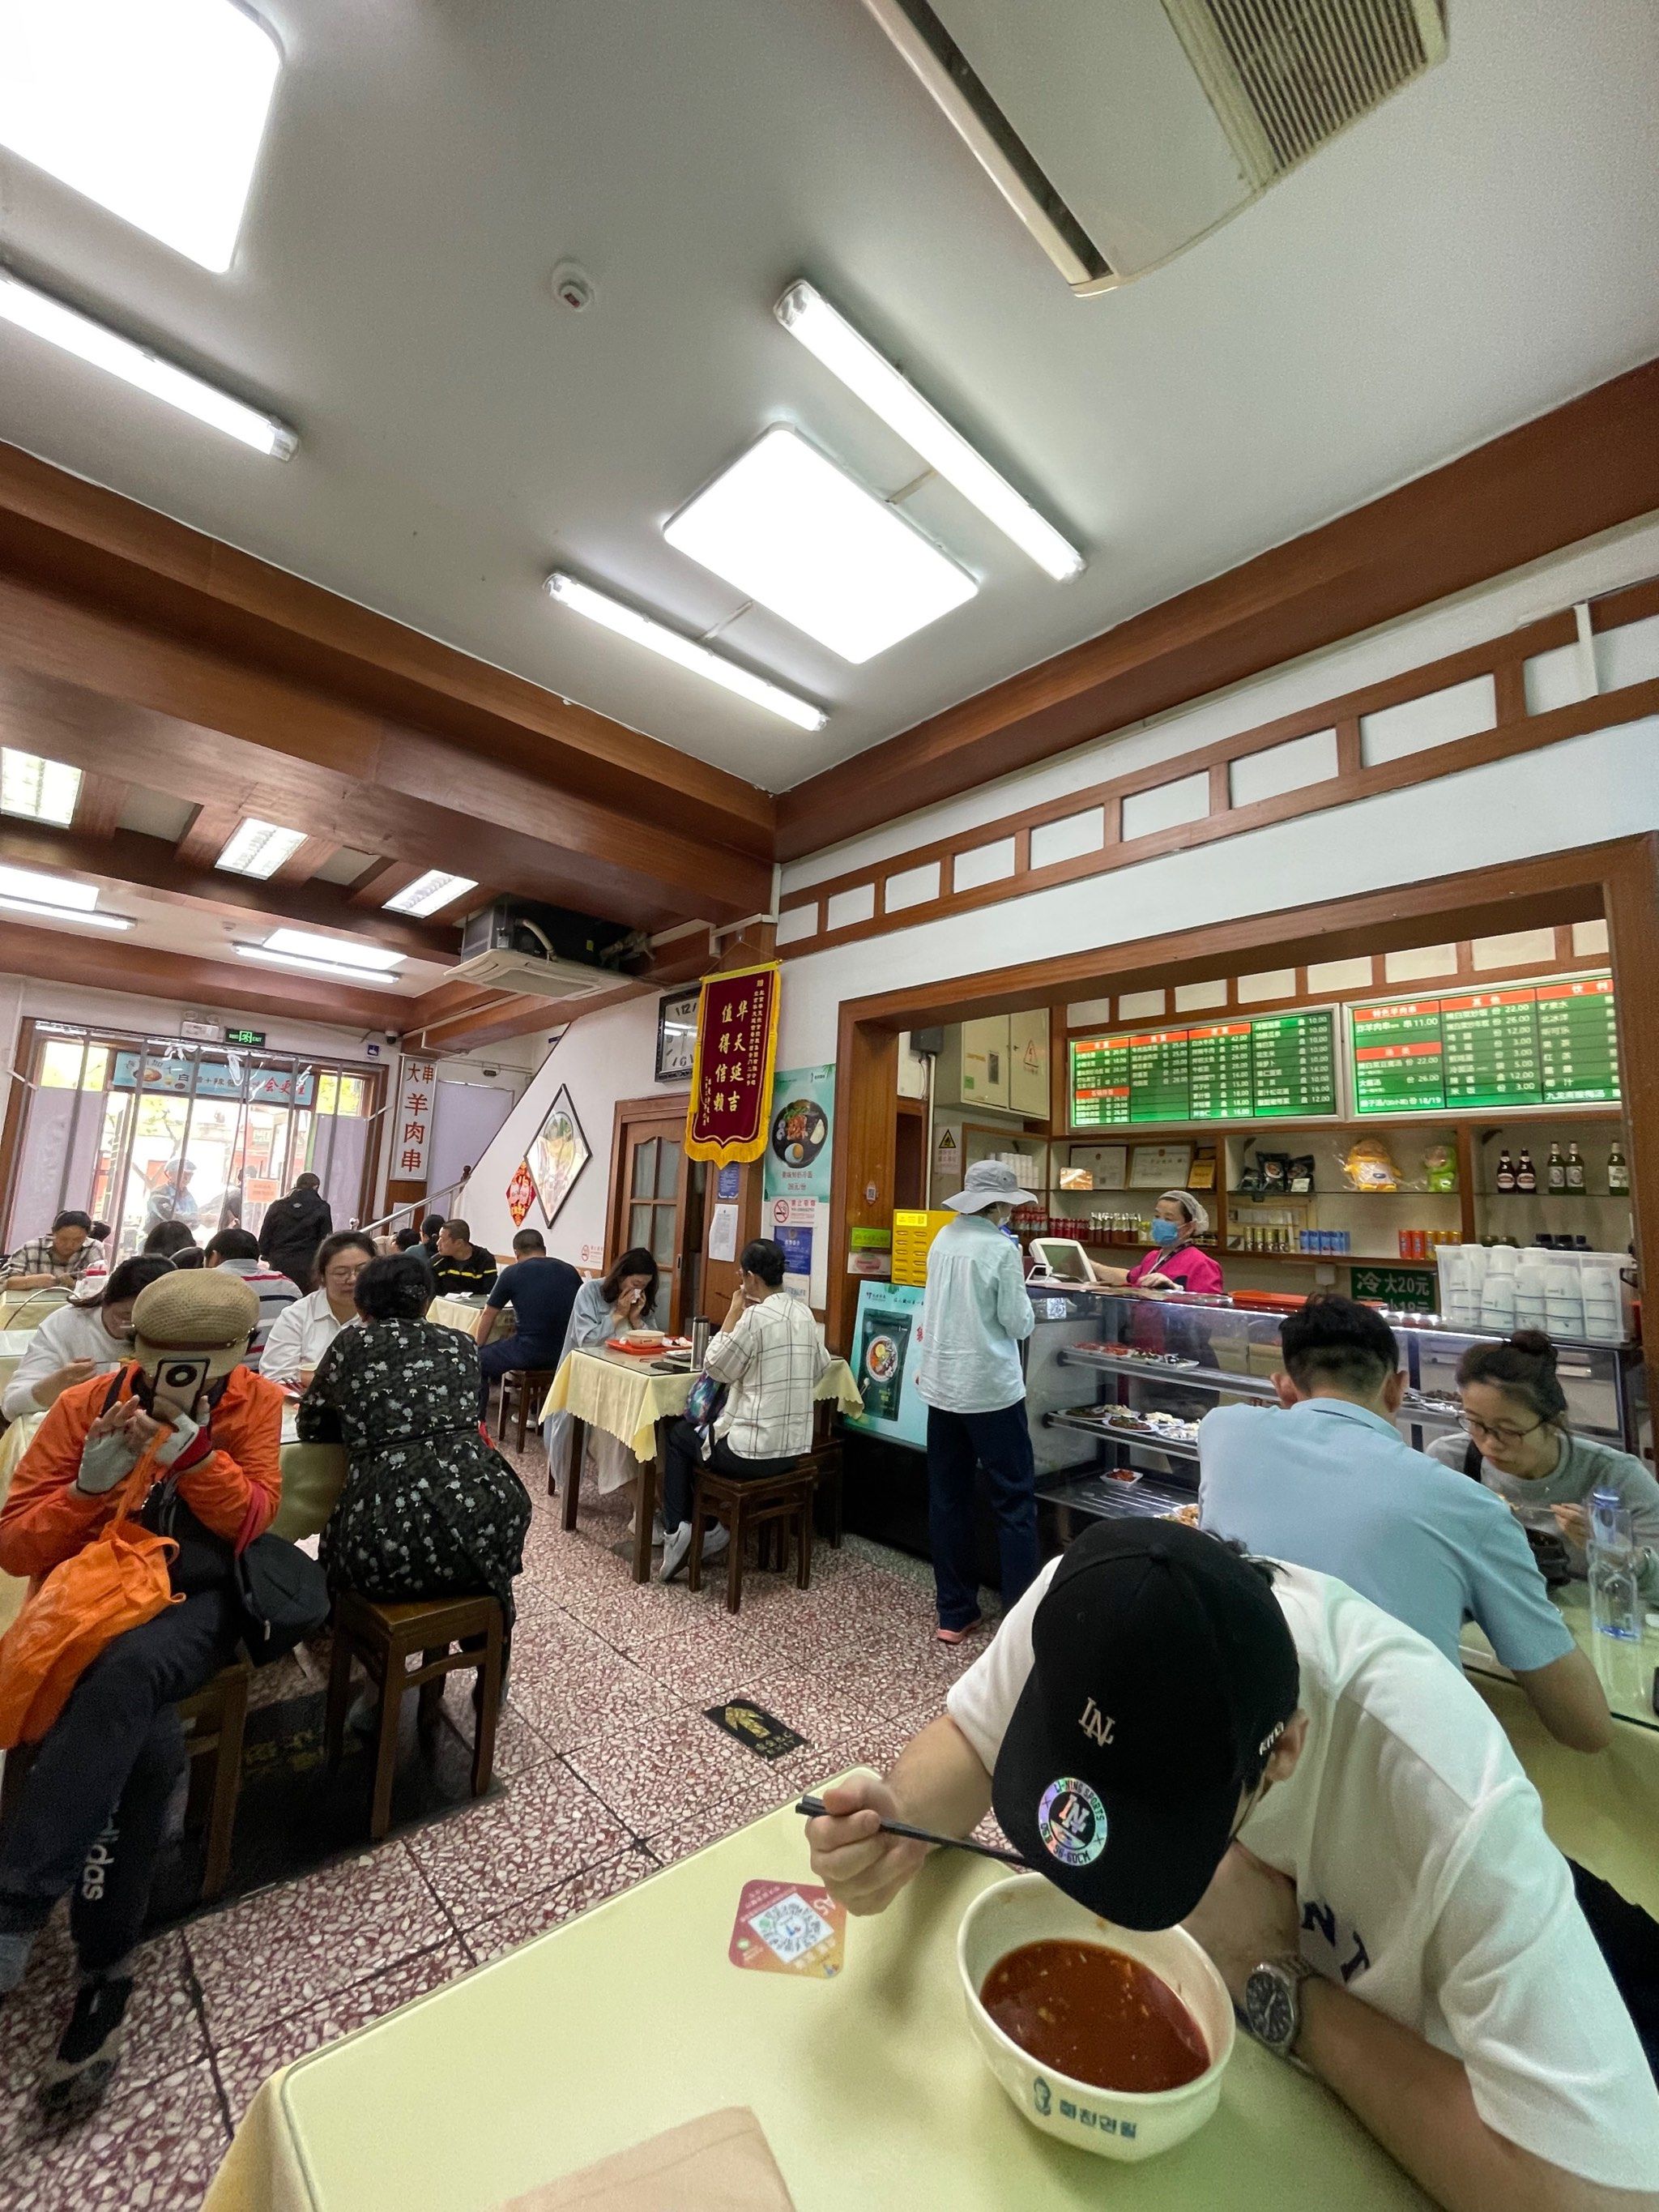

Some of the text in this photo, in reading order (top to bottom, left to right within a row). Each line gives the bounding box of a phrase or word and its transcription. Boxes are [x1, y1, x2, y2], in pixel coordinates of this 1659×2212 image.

[1414, 1018, 1439, 1027] 11.00
[1505, 1004, 1529, 1013] 22.00
[728, 1000, 748, 1112] 华天延吉
[407, 1063, 433, 1084] 大串
[1511, 1071, 1533, 1079] 12.00
[401, 1093, 429, 1172] 羊肉串
[1357, 1271, 1430, 1300] 冷 大20元
[1078, 1697, 1115, 1747] LN
[1059, 1794, 1090, 1833] LN
[1083, 1786, 1106, 1821] SPORTS
